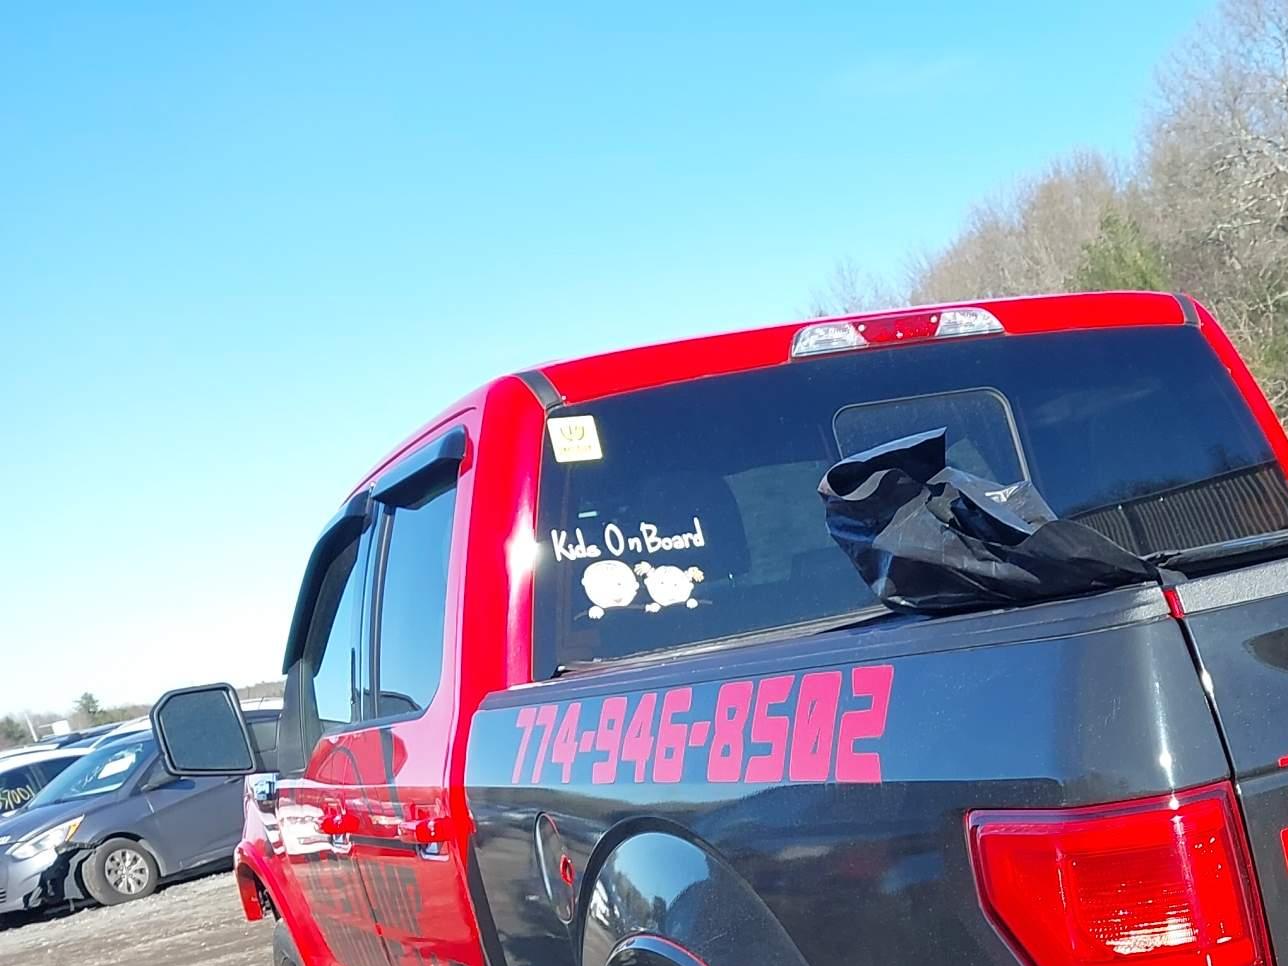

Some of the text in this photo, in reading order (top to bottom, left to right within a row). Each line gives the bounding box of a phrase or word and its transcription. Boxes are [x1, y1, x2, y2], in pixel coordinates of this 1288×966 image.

[551, 527, 602, 562] Kids
[640, 517, 705, 553] Board
[511, 664, 894, 785] 774-946-8502
